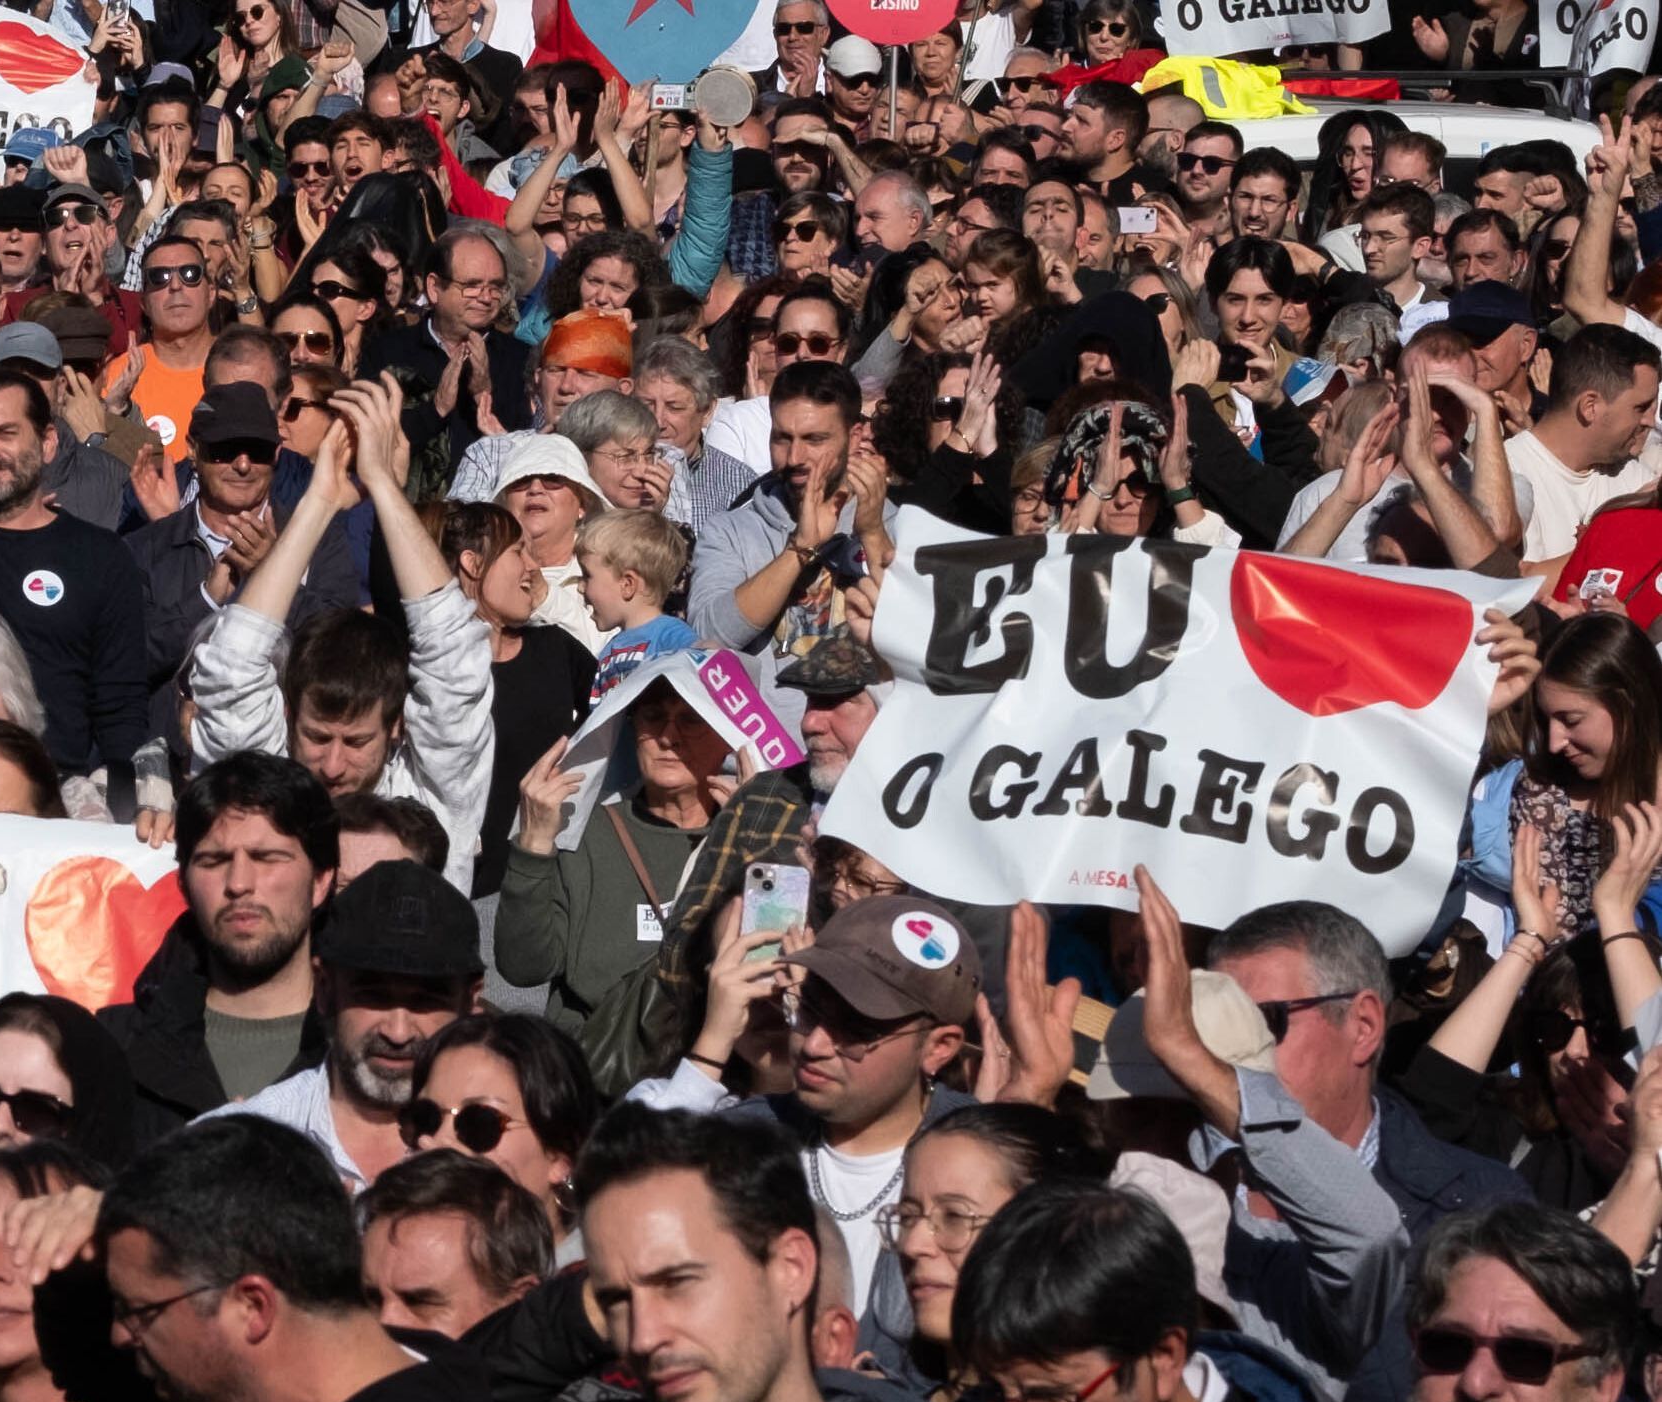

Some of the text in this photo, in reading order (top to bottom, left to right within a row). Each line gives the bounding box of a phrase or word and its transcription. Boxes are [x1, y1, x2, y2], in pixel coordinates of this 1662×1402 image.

[1177, 0, 1203, 31] O
[914, 534, 1212, 699] EU
[881, 730, 1416, 875] O GALEGO
